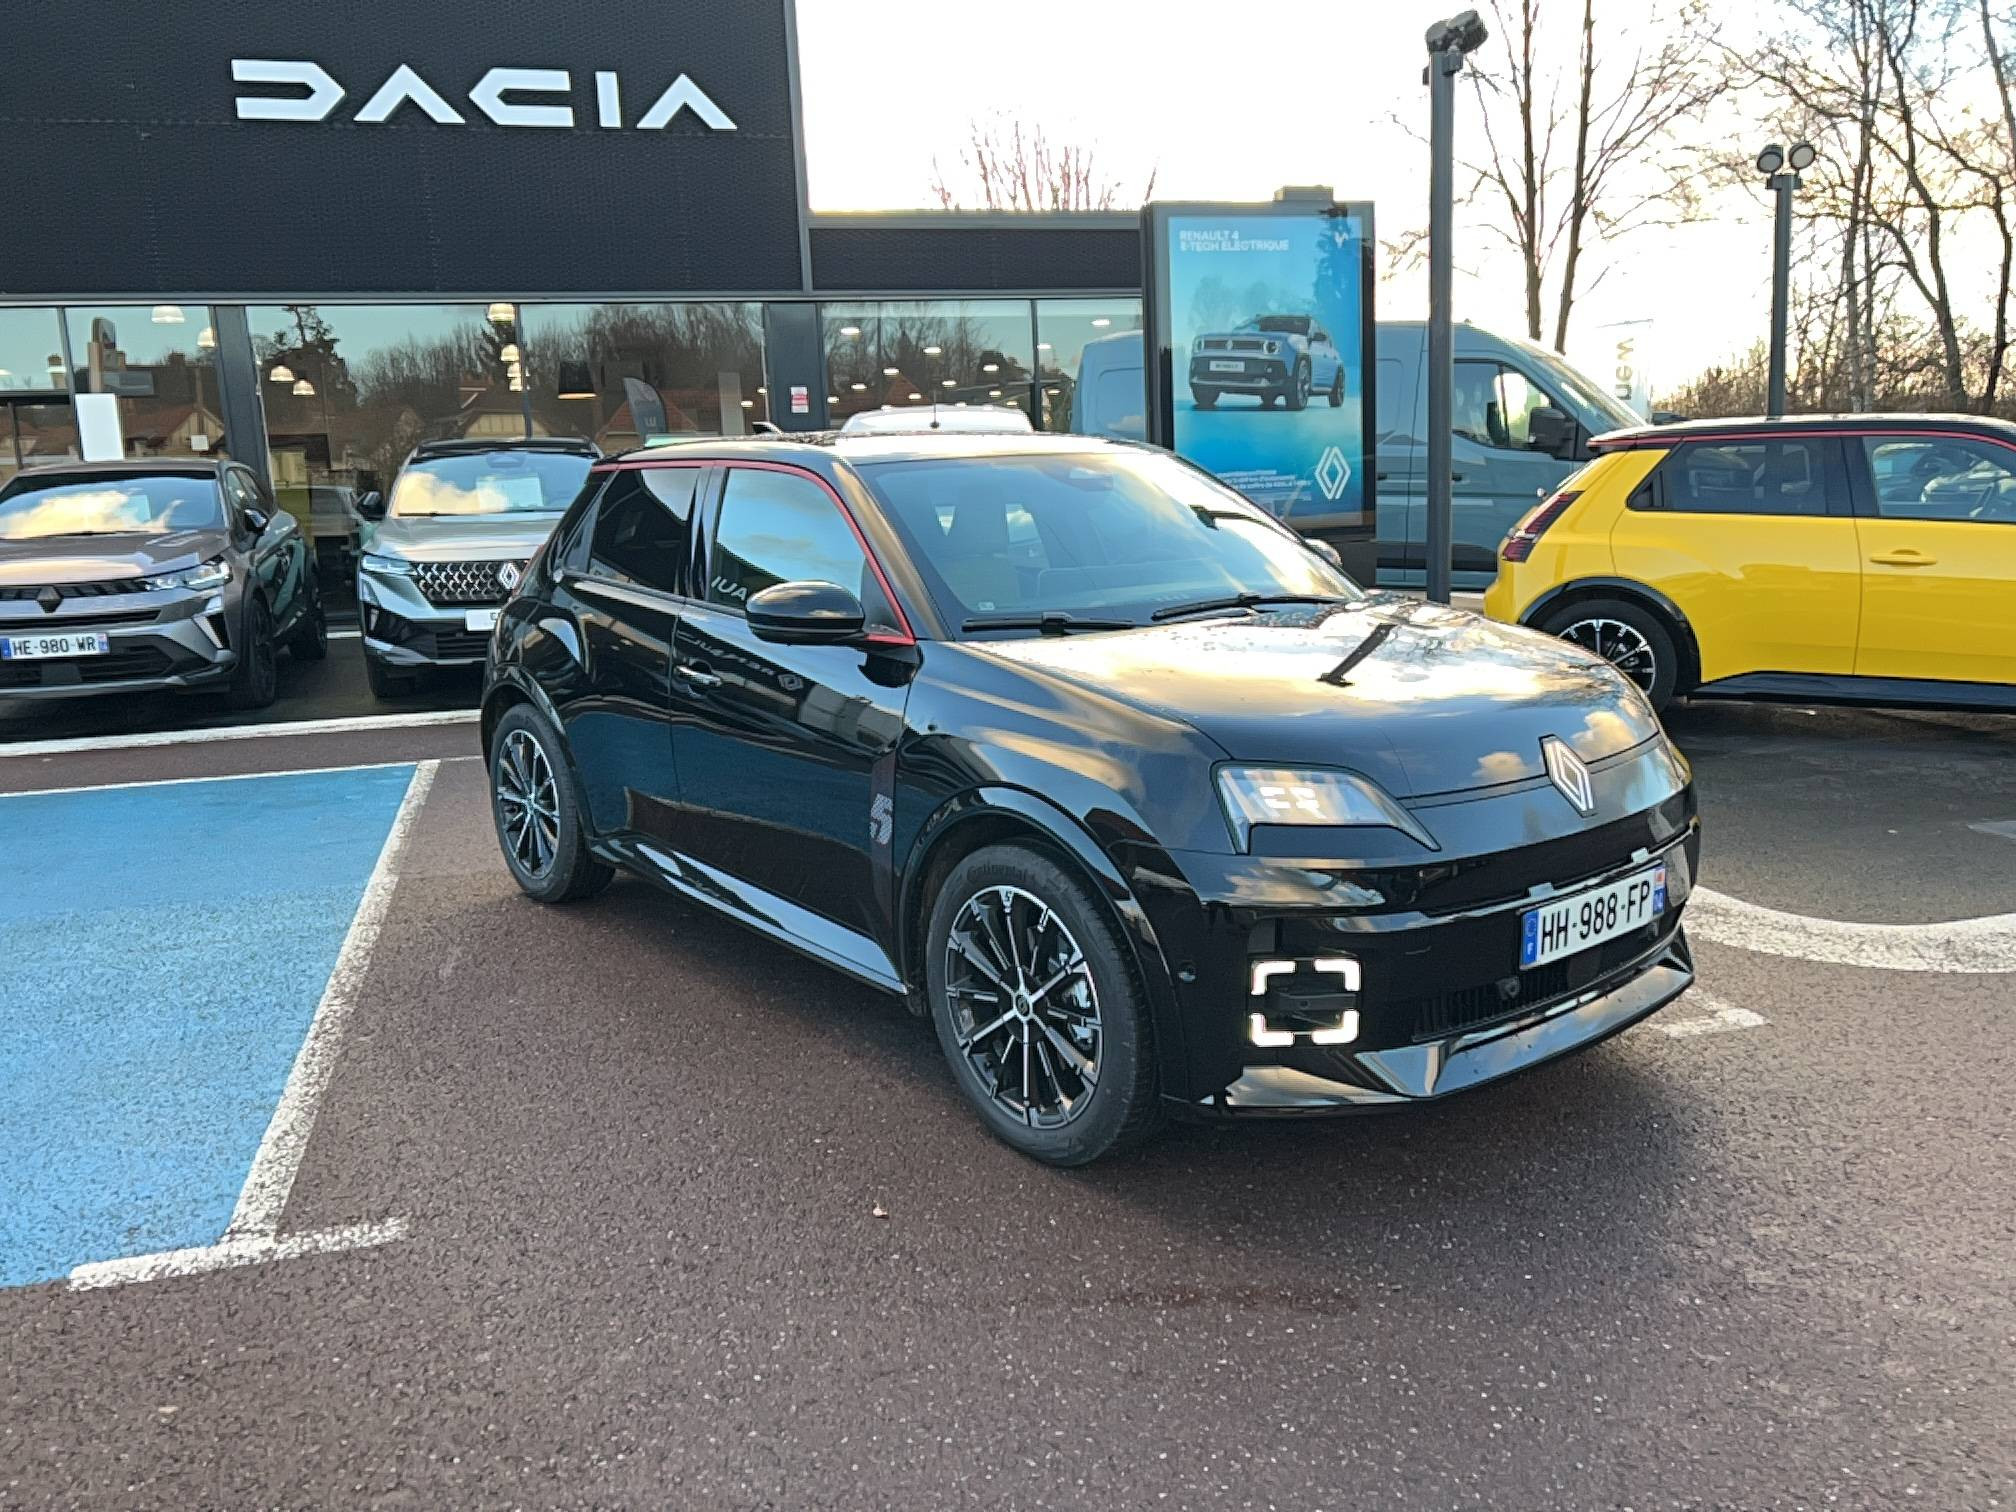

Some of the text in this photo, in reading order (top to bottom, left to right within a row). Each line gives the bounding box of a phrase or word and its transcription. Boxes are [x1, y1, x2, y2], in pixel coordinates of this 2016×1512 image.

[231, 59, 738, 130] DACIA
[1179, 230, 1229, 241] RENAULT
[12, 636, 97, 655] HE-980-WR
[1541, 880, 1651, 955] HH-988-FP
